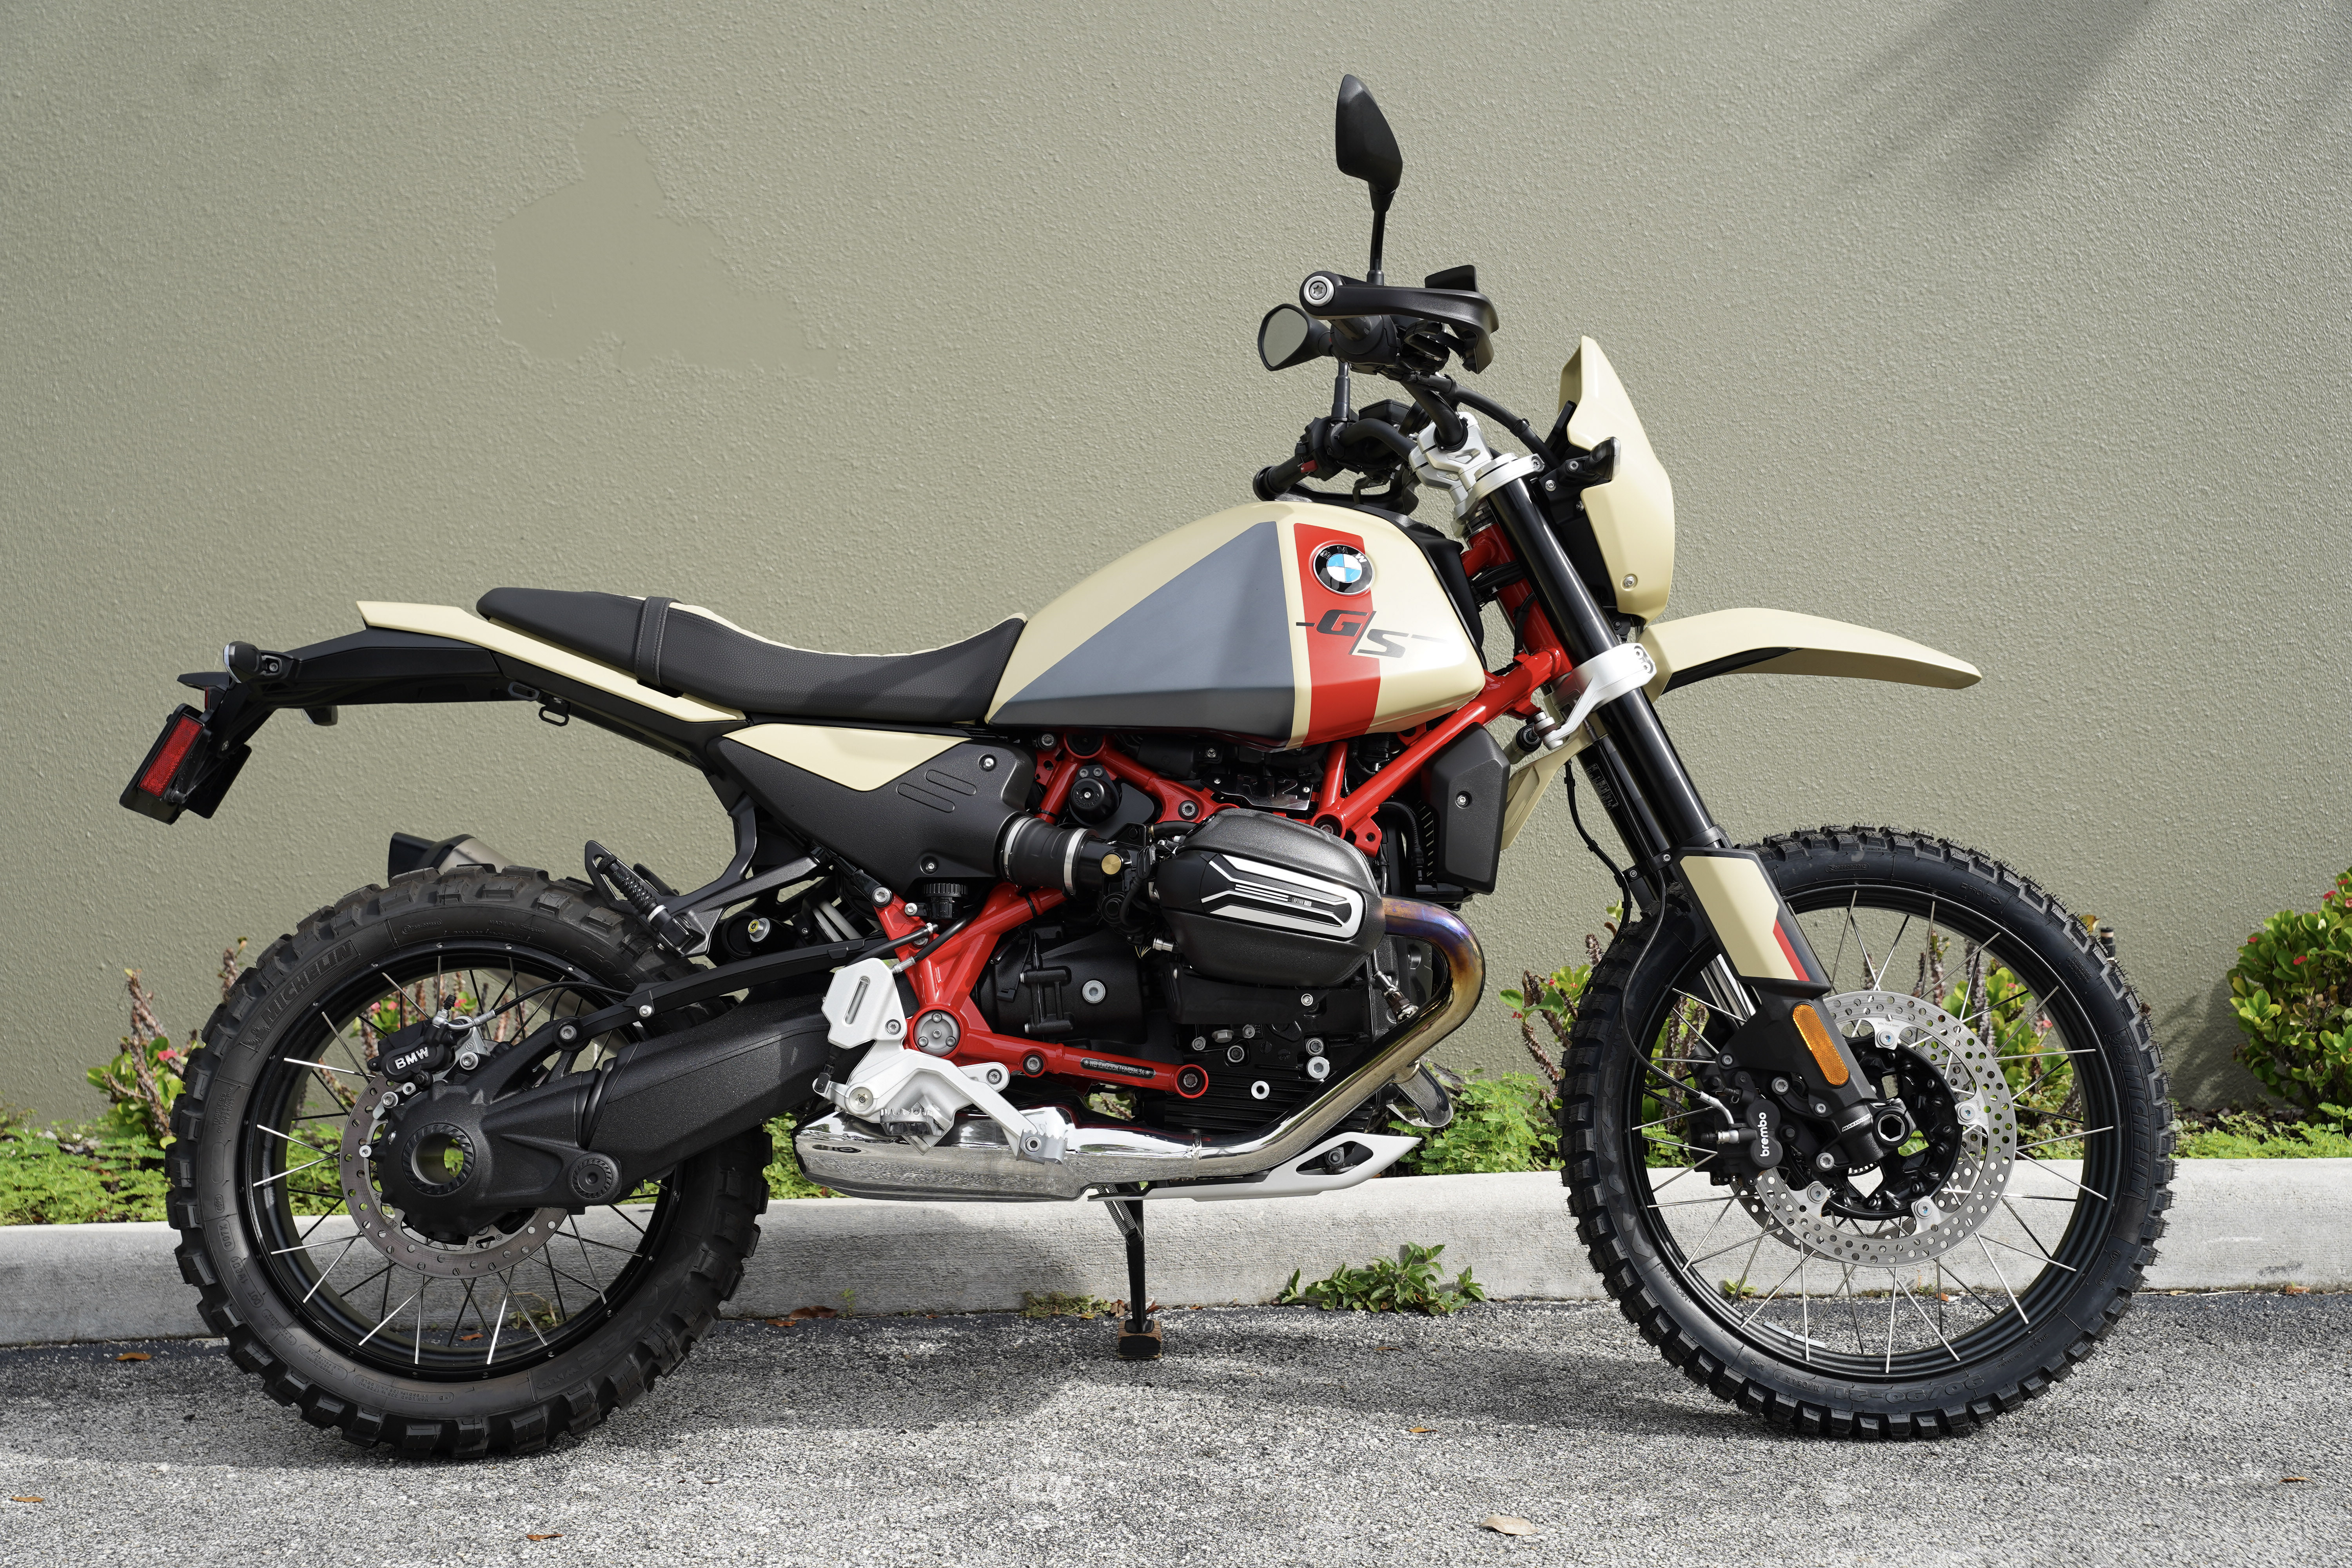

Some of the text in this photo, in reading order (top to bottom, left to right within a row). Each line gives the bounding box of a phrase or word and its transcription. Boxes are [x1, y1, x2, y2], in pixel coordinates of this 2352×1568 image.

[1320, 546, 1367, 563] BMW
[1968, 885, 1991, 900] FRONT
[2071, 955, 2092, 980] TUBELESS
[259, 940, 356, 1025] MICHELIN
[395, 1047, 428, 1069] BMW
[212, 1091, 226, 1126] TUBELESS
[1757, 1112, 1769, 1156] brembo
[2122, 1062, 2151, 1197] MICHELIN
[247, 1289, 262, 1306] DOT
[1663, 1270, 1689, 1301] MICHELIN
[1749, 1359, 1765, 1370] M+S
[361, 1377, 374, 1387] COLD
[1833, 1372, 1985, 1406] 90/90-21
